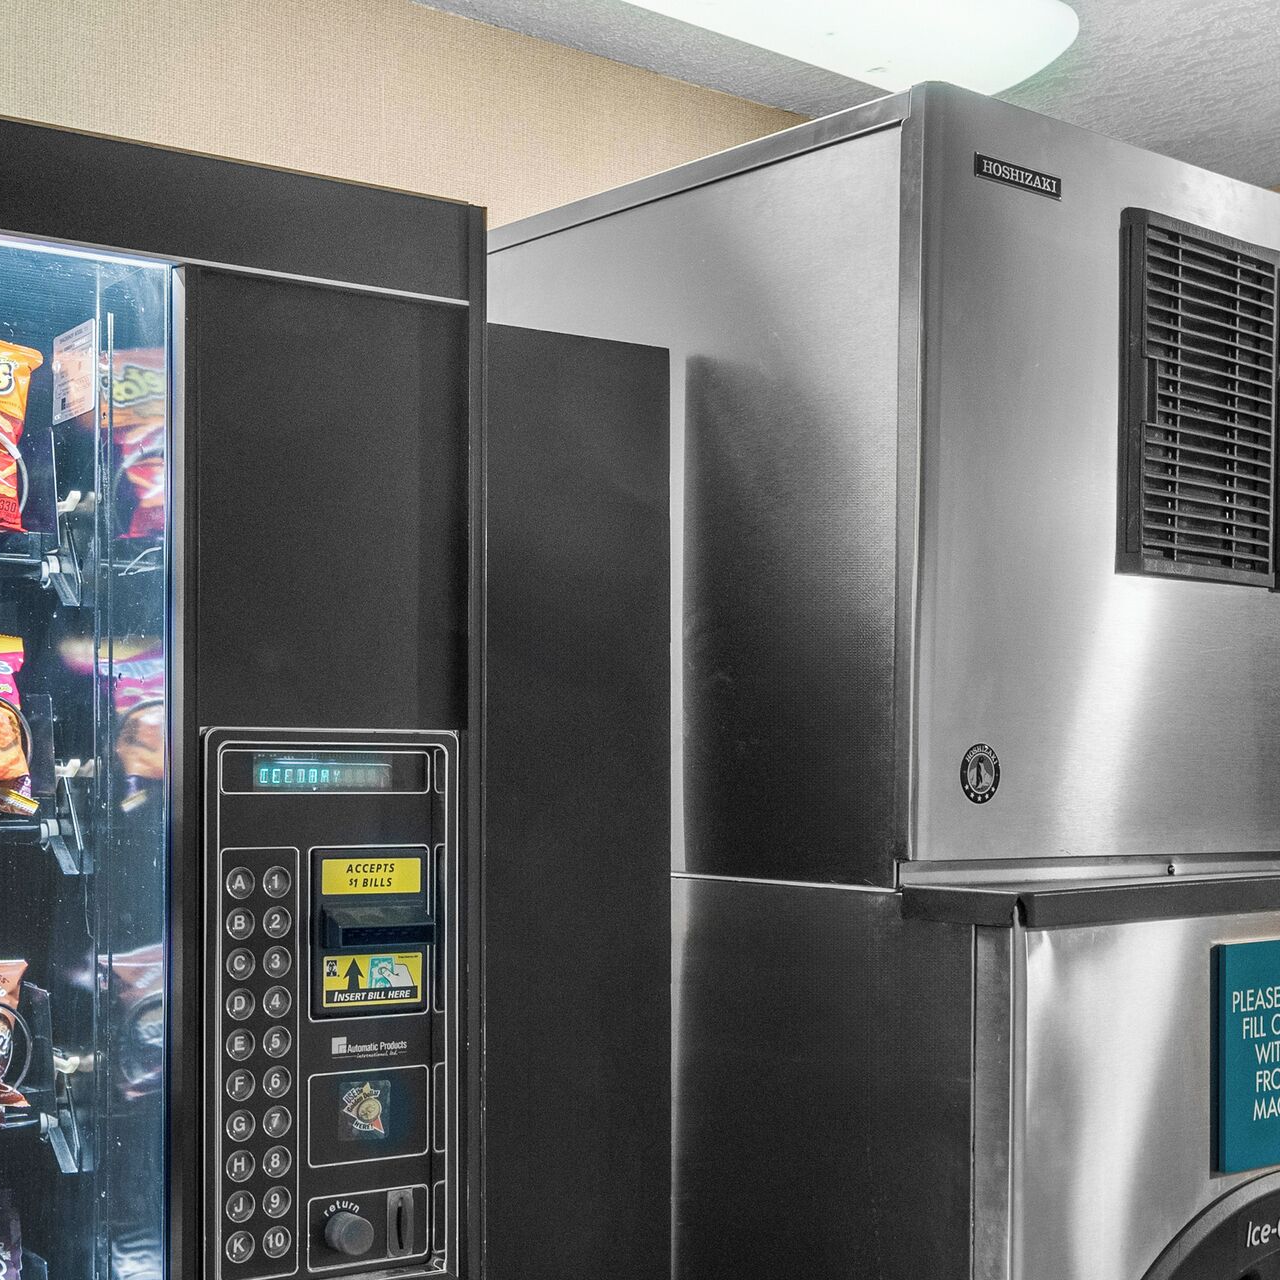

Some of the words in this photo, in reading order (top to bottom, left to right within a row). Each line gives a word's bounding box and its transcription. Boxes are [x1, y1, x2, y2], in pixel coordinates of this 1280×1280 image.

[982, 159, 1057, 193] HOSHIZAKI
[346, 863, 395, 874] ACCEPTS
[233, 875, 246, 890] A
[349, 878, 359, 888] $1
[362, 877, 393, 888] BILLS
[234, 995, 246, 1011] D
[270, 993, 281, 1008] 4
[333, 991, 367, 1003] INSERT
[368, 990, 387, 1000] BILL
[387, 989, 411, 999] HERE
[1242, 1017, 1266, 1040] FILL
[234, 1036, 245, 1051] E
[271, 1034, 281, 1049] 5
[347, 1042, 379, 1054] Automatic
[379, 1040, 407, 1050] Products
[234, 1077, 245, 1092] F
[271, 1074, 281, 1088] 6
[234, 1117, 246, 1132] G
[271, 1114, 281, 1129] 7
[234, 1157, 245, 1172] H
[270, 1153, 280, 1168] 8
[234, 1198, 244, 1212] J
[270, 1194, 280, 1209] 9
[323, 1200, 361, 1218] return
[233, 1238, 245, 1253] K
[267, 1233, 284, 1249] 10
